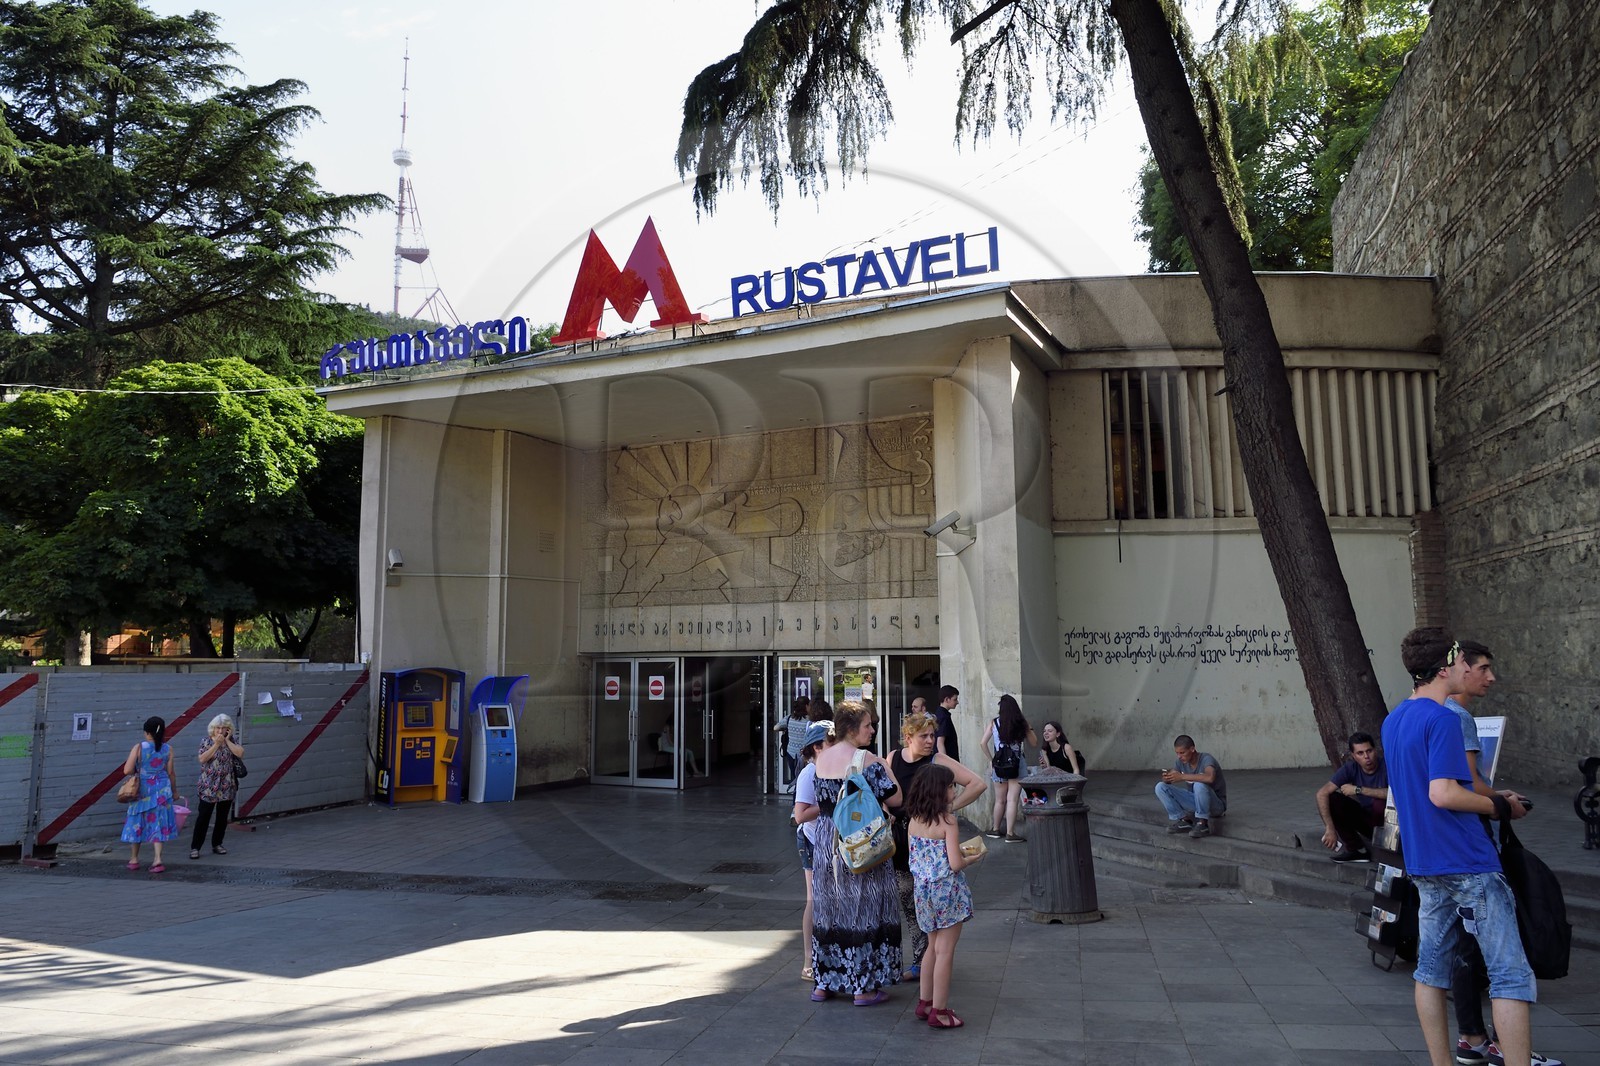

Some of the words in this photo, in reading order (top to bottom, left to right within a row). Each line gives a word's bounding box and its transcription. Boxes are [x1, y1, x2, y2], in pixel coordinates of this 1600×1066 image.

[731, 226, 999, 318] RUSTAVELI
[320, 316, 531, 379] რუსთაველი
[1271, 630, 1281, 642] და
